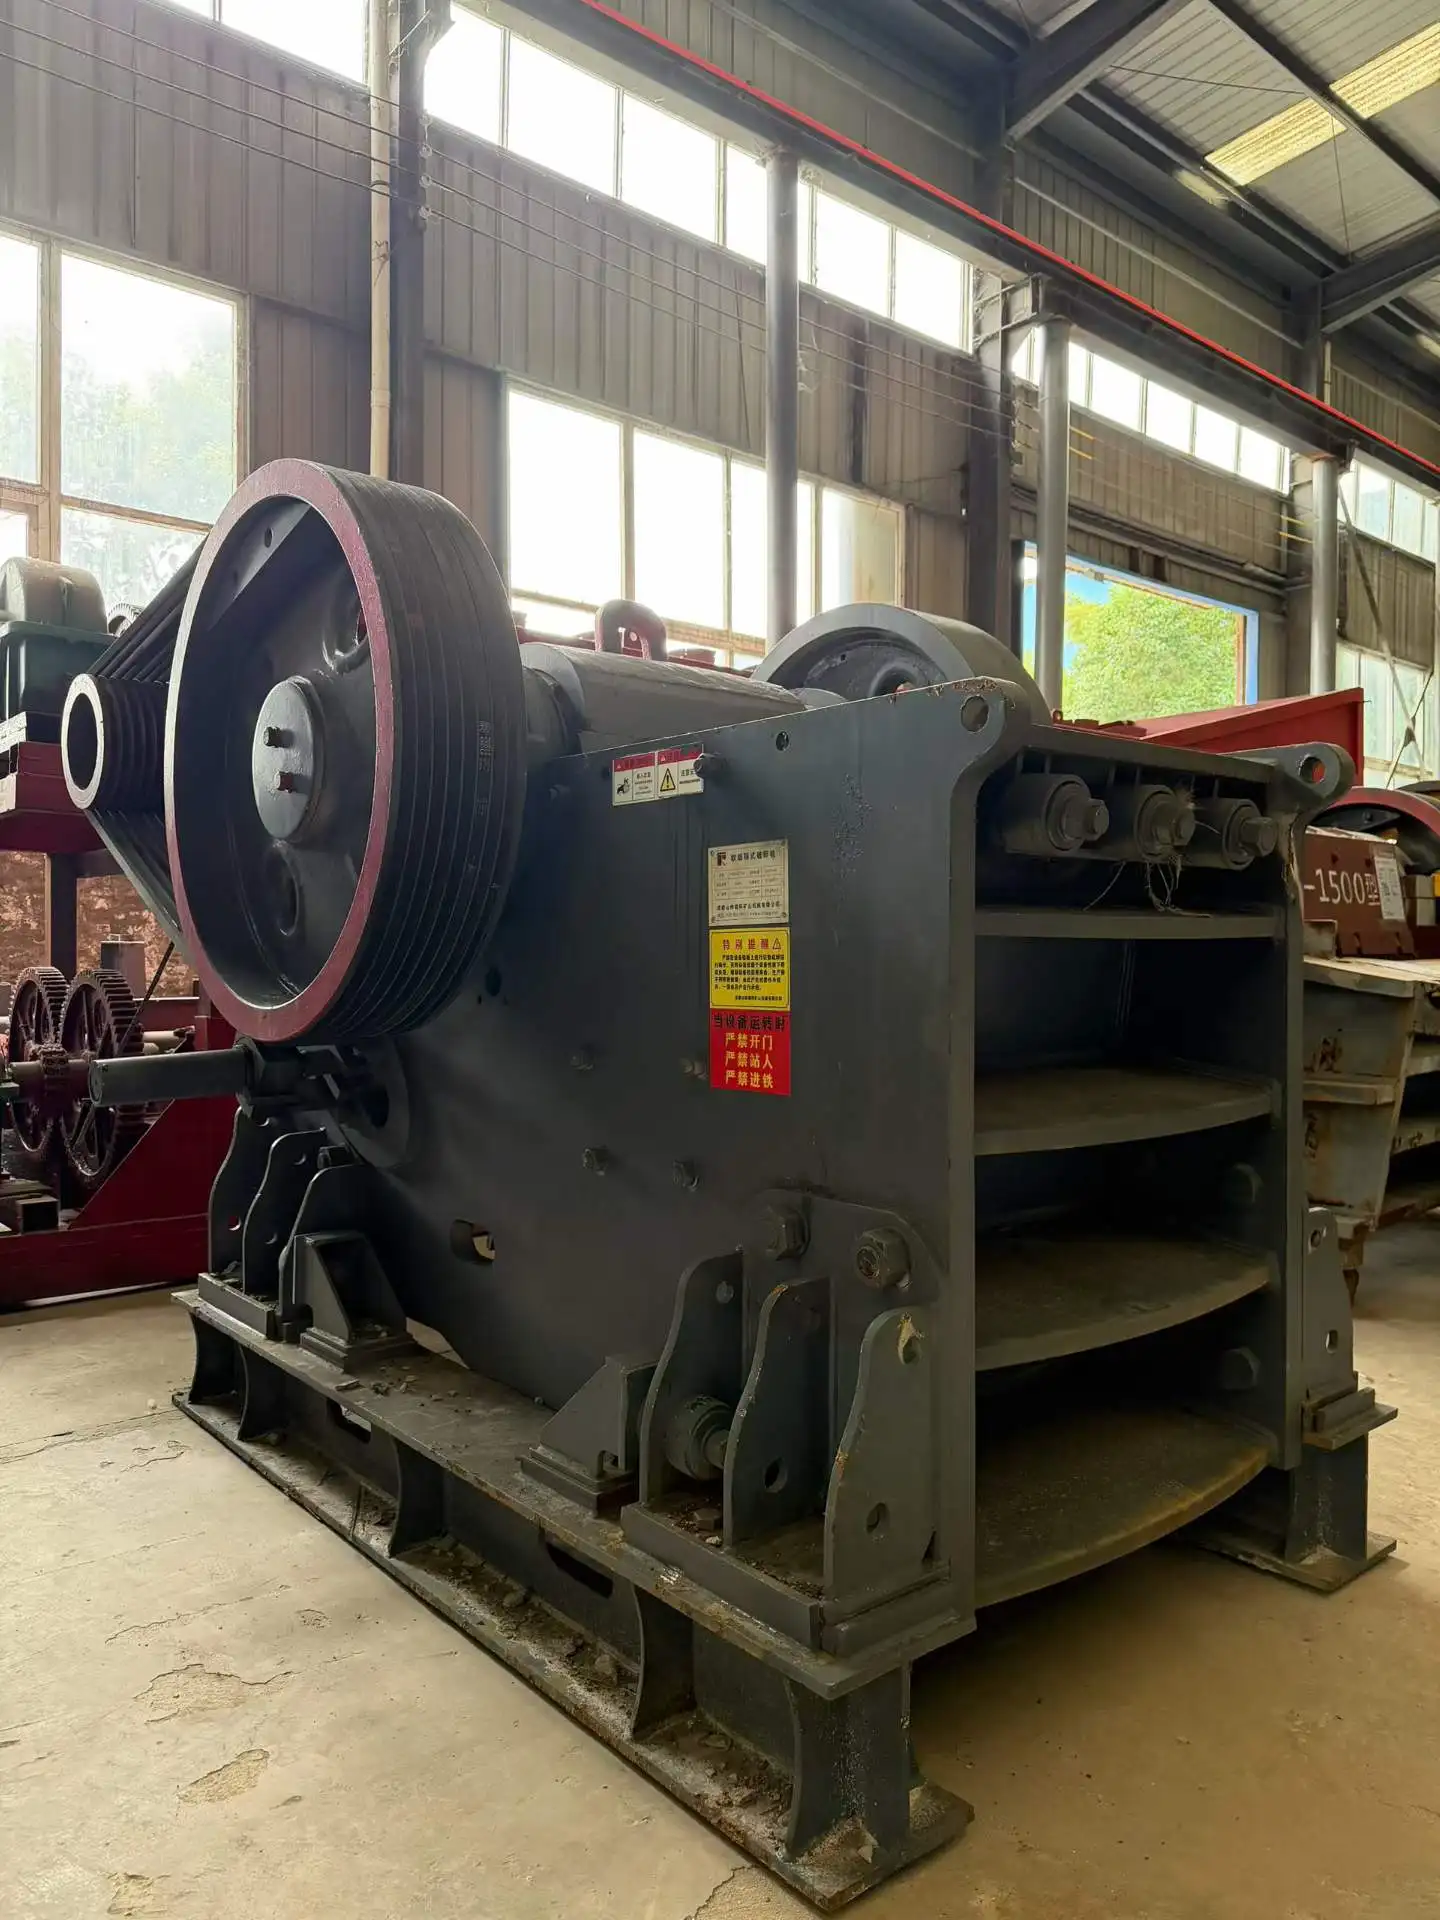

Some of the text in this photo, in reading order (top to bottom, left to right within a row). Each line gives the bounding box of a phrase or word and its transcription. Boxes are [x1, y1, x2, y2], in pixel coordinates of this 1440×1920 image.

[723, 938, 770, 951] 特别提醒
[714, 1013, 785, 1031] 当设备运转时
[725, 1032, 773, 1051] 严禁开门
[725, 1051, 773, 1069] 严禁站人
[725, 1069, 774, 1089] 严禁进铁
